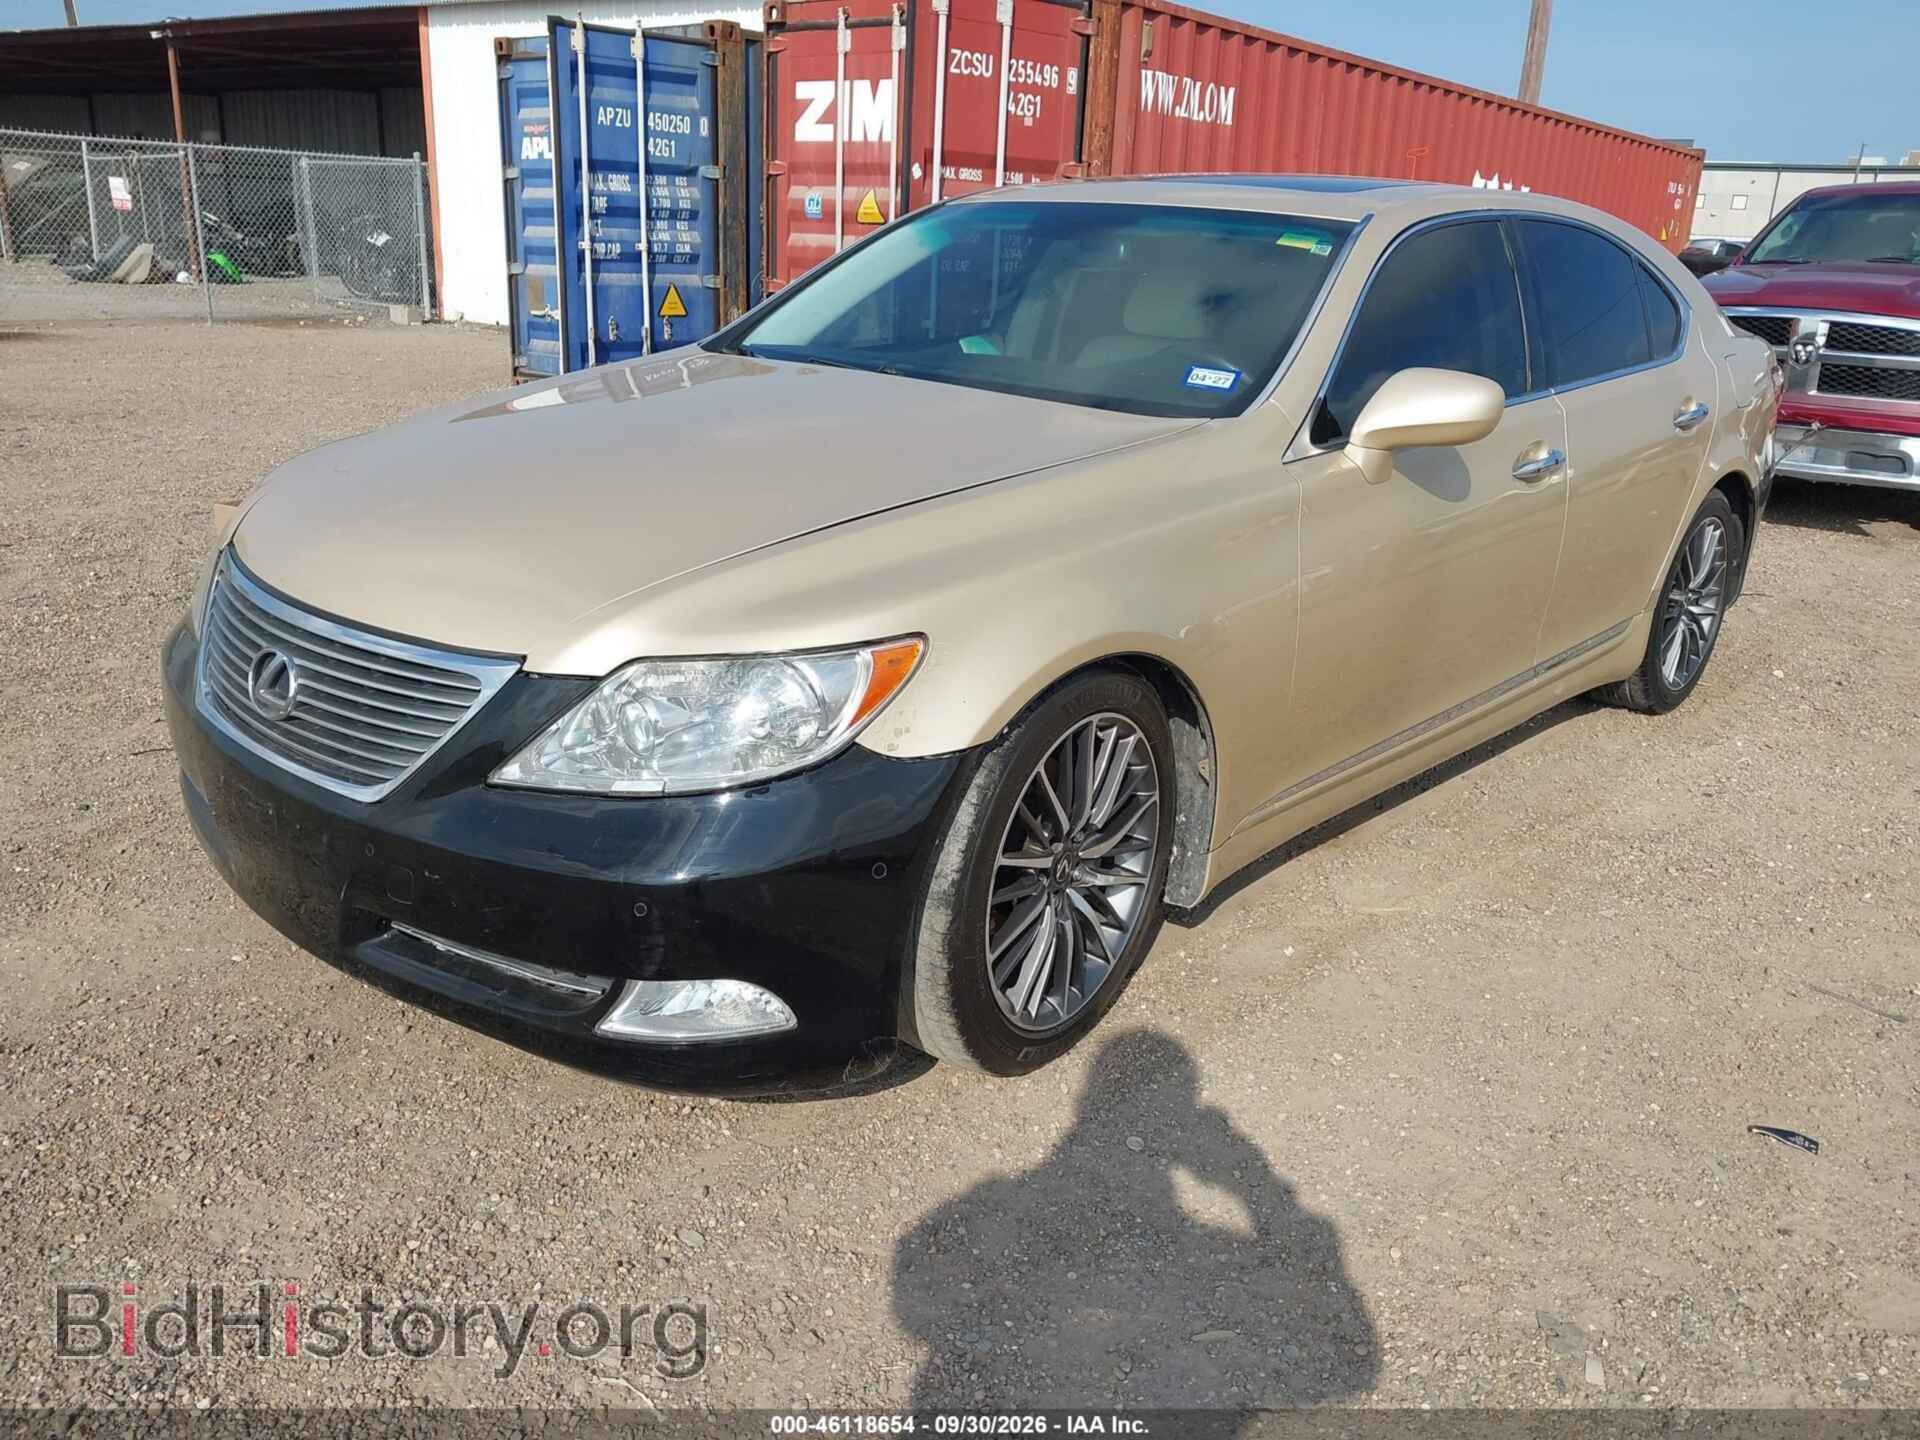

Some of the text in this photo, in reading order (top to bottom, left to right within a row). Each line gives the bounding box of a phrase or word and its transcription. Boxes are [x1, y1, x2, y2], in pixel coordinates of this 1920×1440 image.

[950, 49, 1077, 93] ZCSU 255496 9
[795, 79, 893, 142] ZIM
[1008, 92, 1040, 117] 42G1
[598, 106, 632, 128] APZU
[648, 112, 691, 134] 450250
[521, 136, 552, 160] APL
[648, 138, 676, 157] 42G1
[608, 174, 632, 192] GROSS
[959, 167, 982, 182] GROSS
